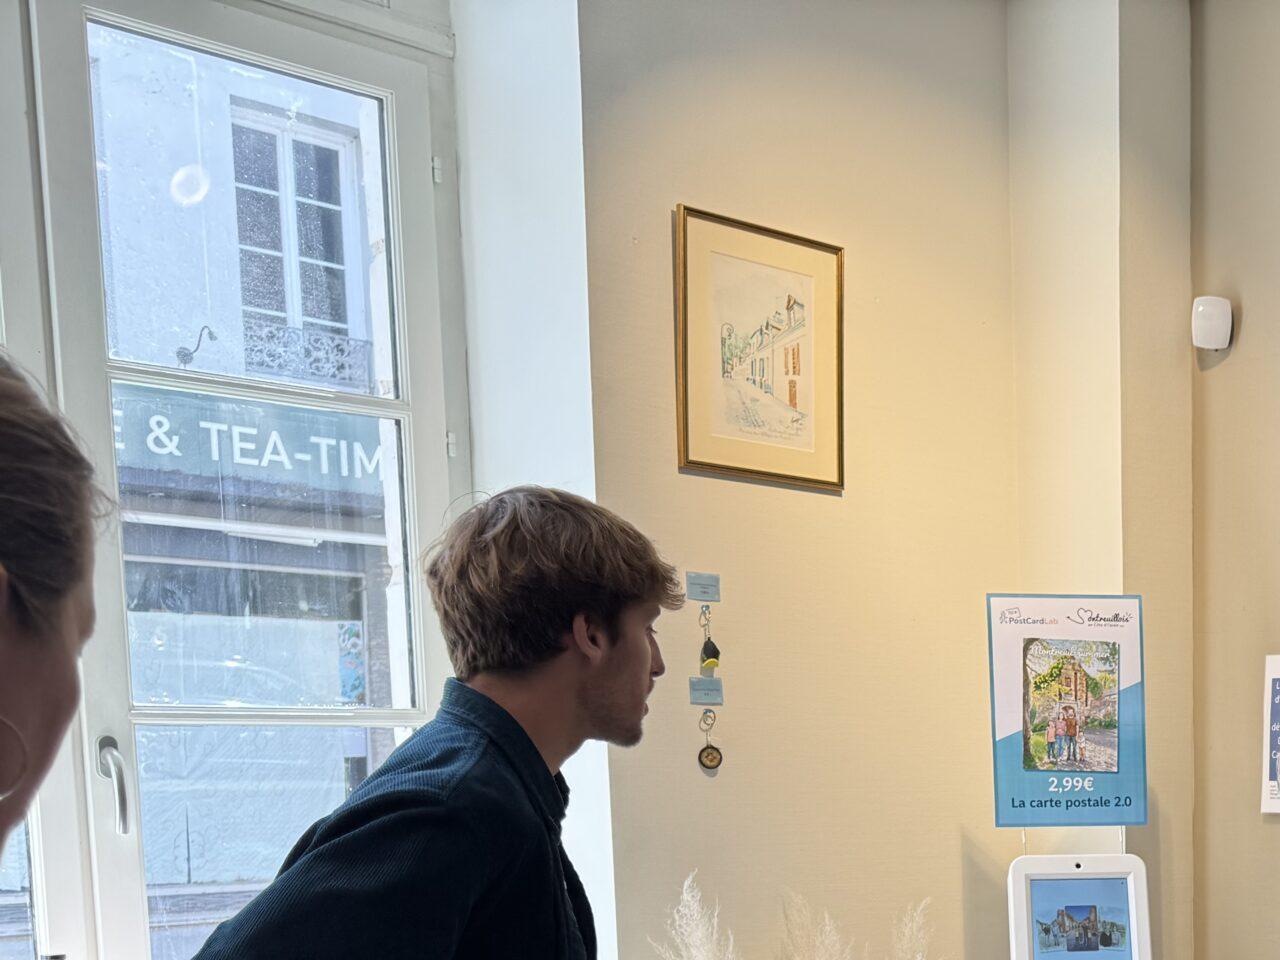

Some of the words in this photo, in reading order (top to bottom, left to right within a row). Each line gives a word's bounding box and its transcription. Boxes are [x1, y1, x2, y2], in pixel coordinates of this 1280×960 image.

[146, 414, 183, 457] &
[1048, 777, 1095, 793] 2,99€
[1011, 797, 1026, 808] La
[1029, 797, 1062, 808] carte
[1065, 796, 1111, 811] postale
[1114, 796, 1132, 807] 2.0
